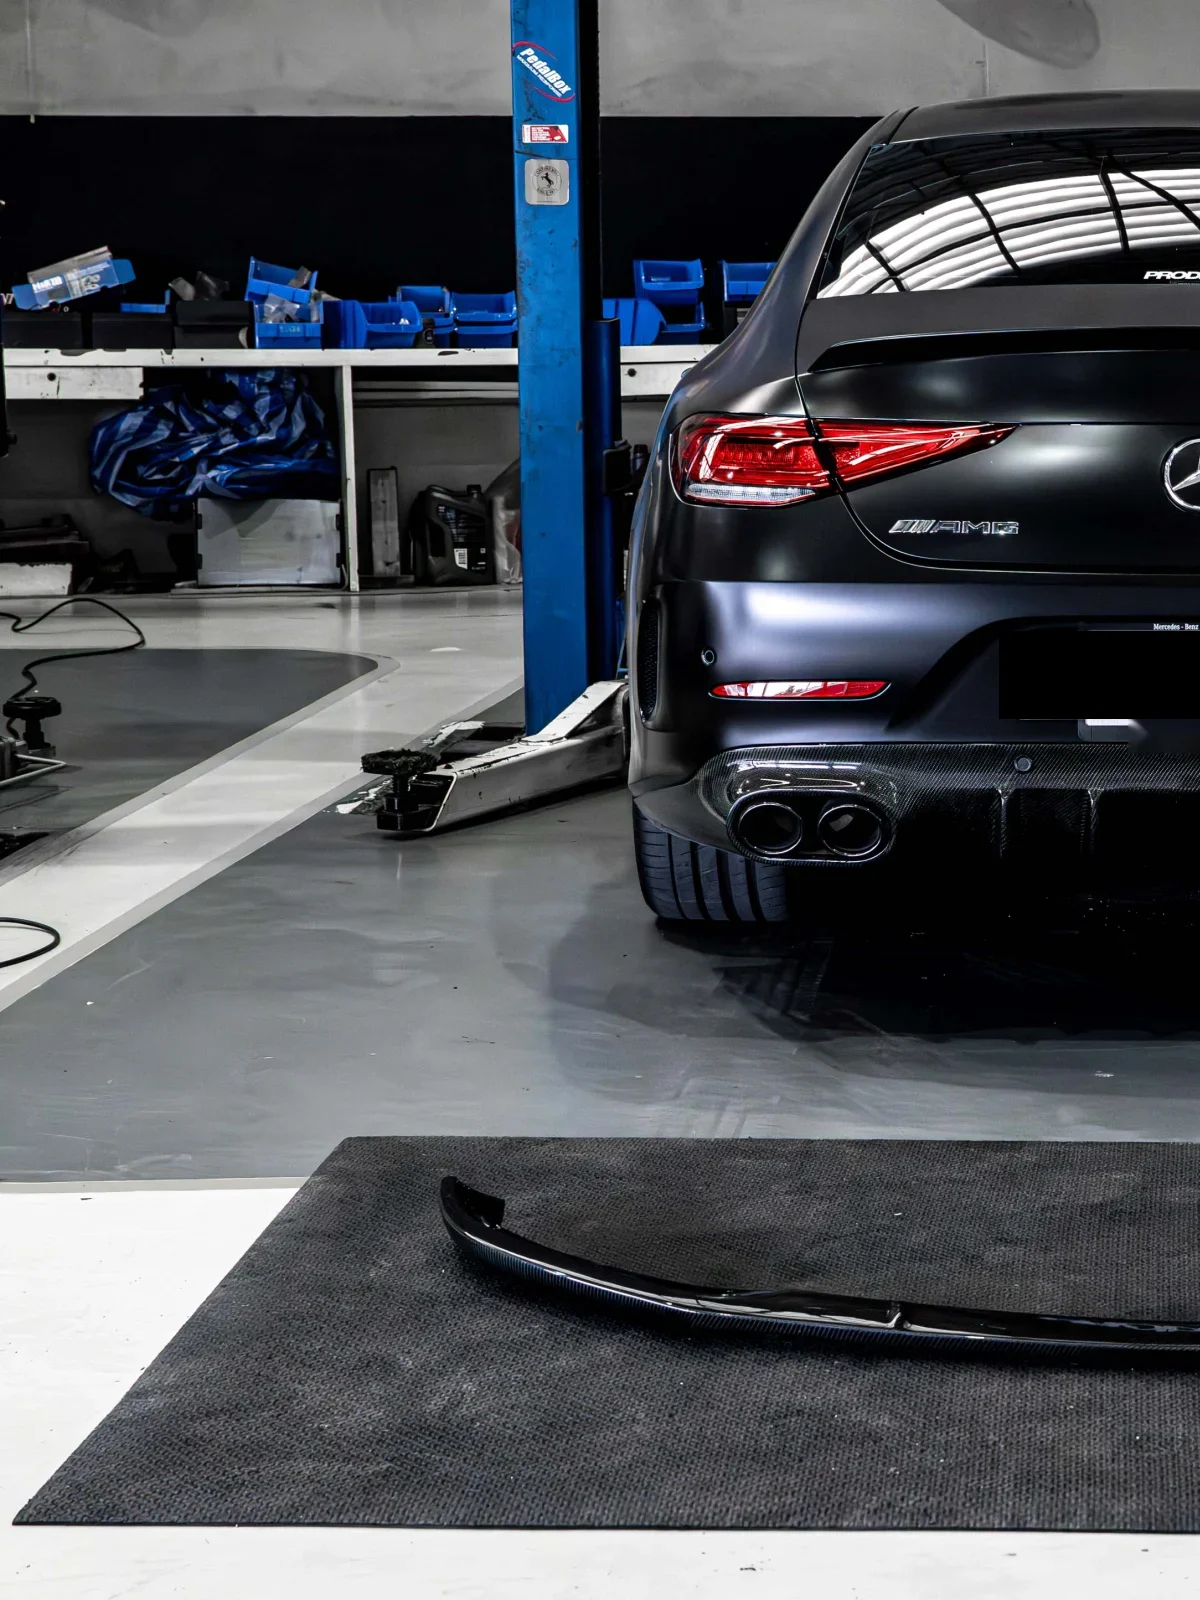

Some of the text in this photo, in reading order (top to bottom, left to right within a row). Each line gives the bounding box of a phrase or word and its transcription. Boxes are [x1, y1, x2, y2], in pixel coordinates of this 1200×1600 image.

[519, 47, 572, 95] PedalBox
[930, 520, 1019, 535] AMG
[1153, 623, 1180, 631] Mercedes
[1184, 623, 1199, 631] Benz
